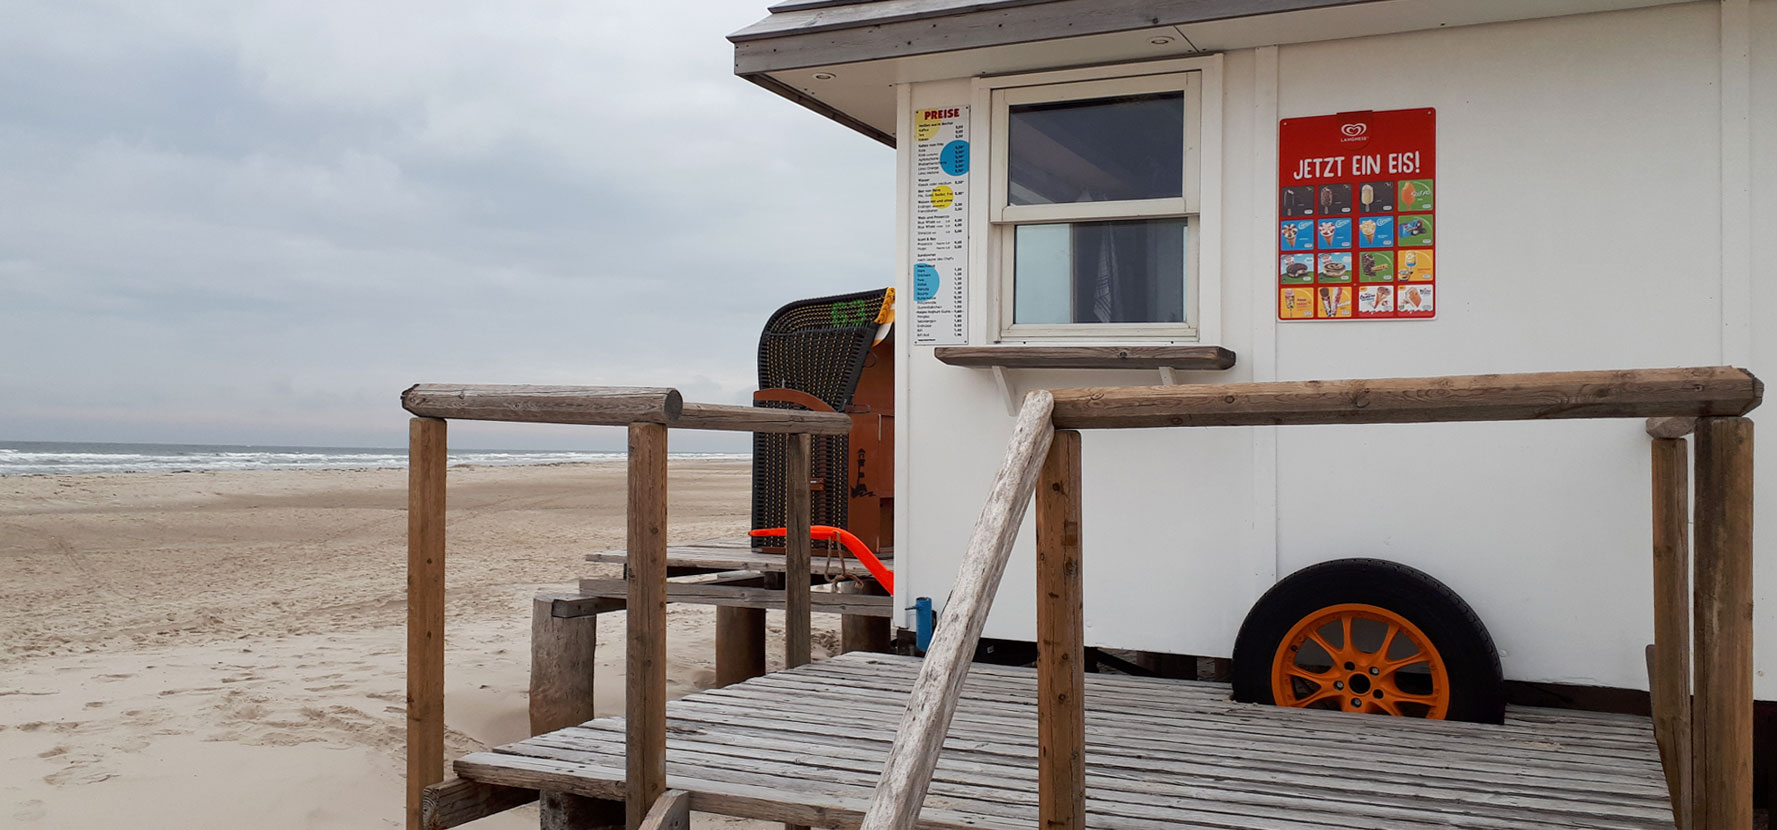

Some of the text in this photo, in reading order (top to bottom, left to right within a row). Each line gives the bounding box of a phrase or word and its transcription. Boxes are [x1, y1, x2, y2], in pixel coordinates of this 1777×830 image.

[924, 108, 960, 120] PREISE
[1293, 151, 1421, 180] JETZT EIN EIS!
[832, 300, 865, 327] 63
